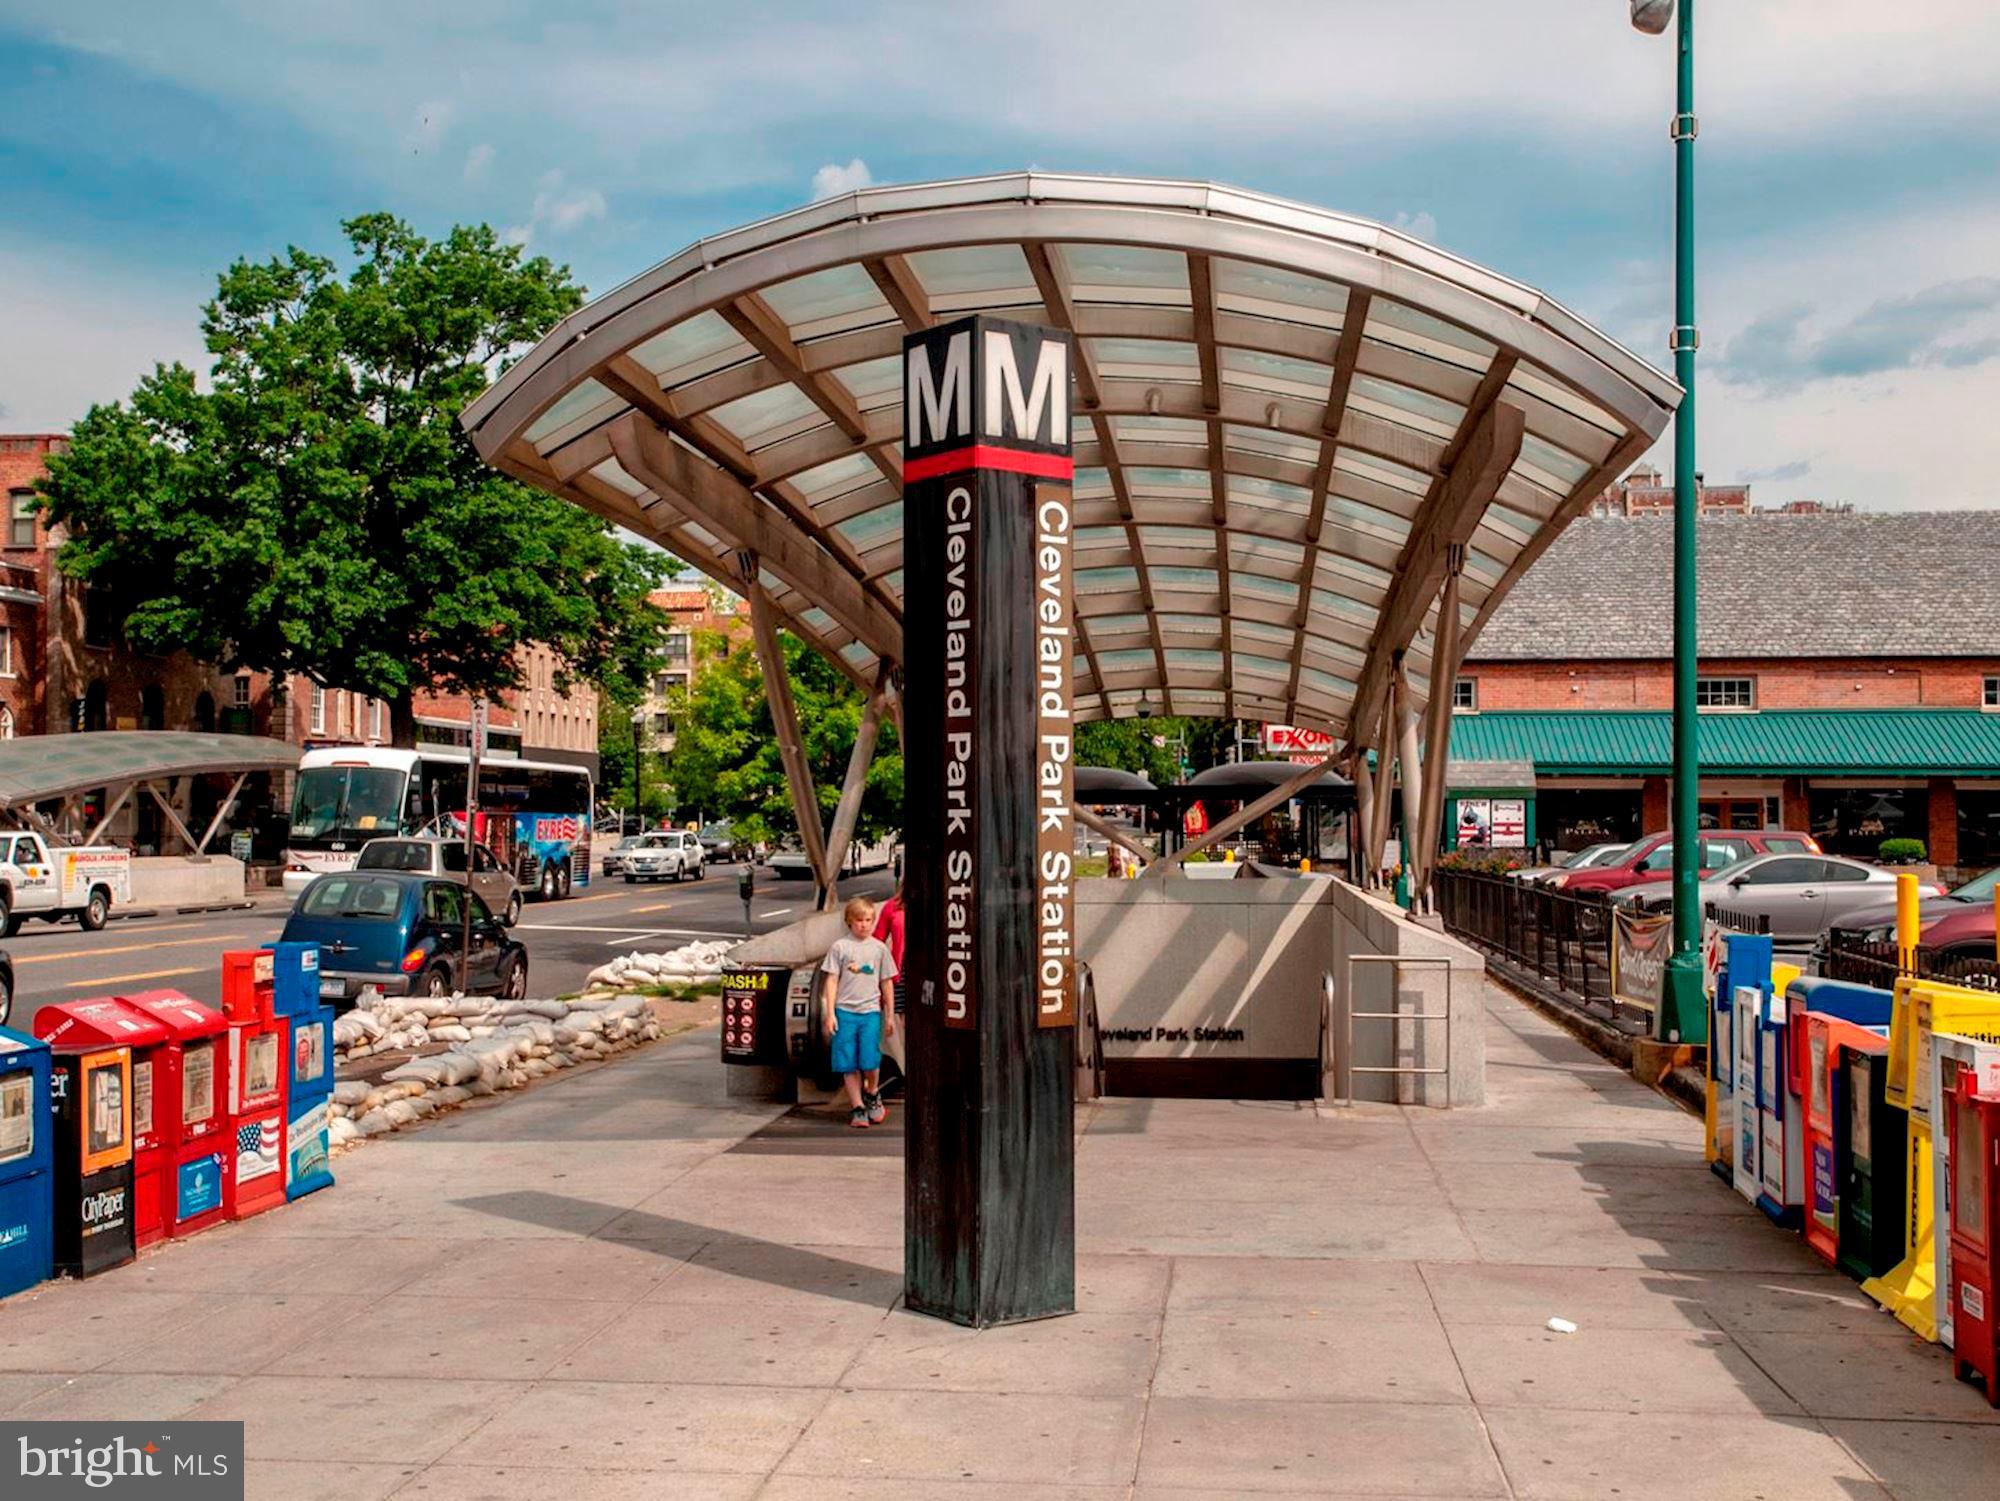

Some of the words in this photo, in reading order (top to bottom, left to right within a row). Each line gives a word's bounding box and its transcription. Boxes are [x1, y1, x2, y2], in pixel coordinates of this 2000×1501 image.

[908, 330, 971, 447] M
[985, 330, 1067, 445] M
[946, 487, 971, 717] Cleveland
[1039, 500, 1069, 718] Cleveland
[947, 732, 972, 835] Park
[1041, 735, 1070, 833] Park
[1273, 728, 1333, 749] EXXON
[324, 852, 352, 862] EYRE
[537, 819, 562, 840] EYRE
[722, 973, 757, 989] RASH
[948, 851, 972, 1019] Station
[1041, 851, 1071, 1014] Station
[1100, 1027, 1152, 1041] eveland
[1156, 1027, 1189, 1041] Park
[1194, 1026, 1244, 1041] Station
